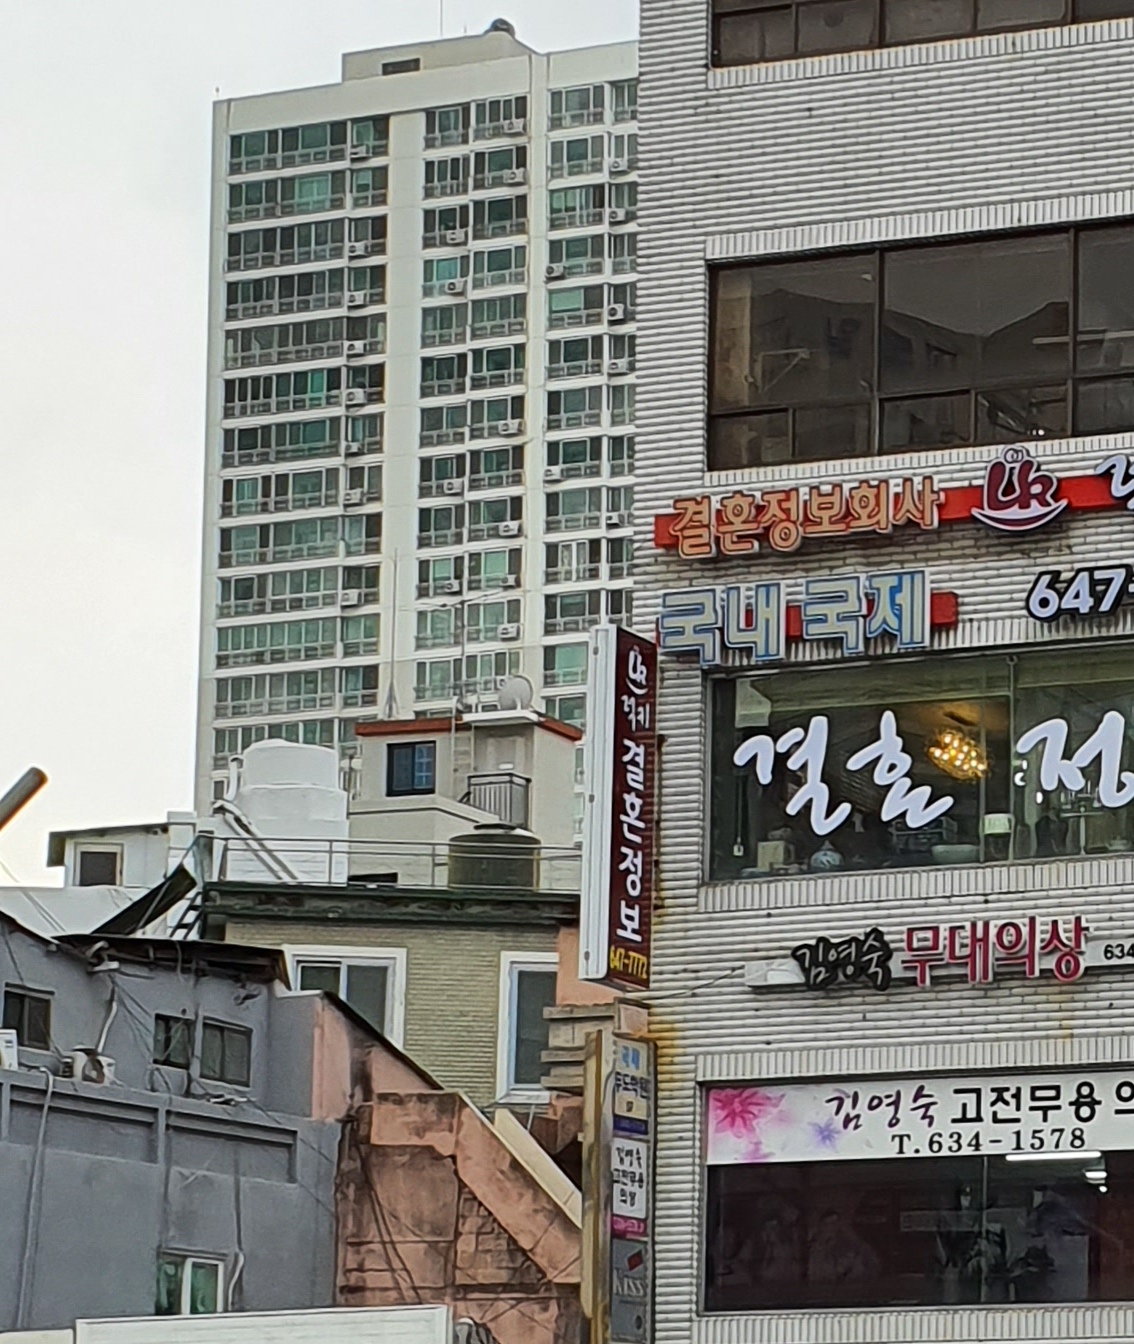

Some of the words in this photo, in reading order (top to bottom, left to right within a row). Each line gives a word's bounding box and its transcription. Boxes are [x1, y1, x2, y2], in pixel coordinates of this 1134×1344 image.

[669, 475, 941, 558] 결혼정보회사
[659, 582, 784, 665] 국내
[802, 570, 930, 655] 국제
[616, 738, 646, 943] 결혼정보
[794, 931, 888, 987] 김영숙
[901, 915, 1091, 987] 무대의상
[825, 1084, 939, 1131] 김영숙
[950, 1080, 1102, 1125] 고전무용
[890, 1127, 1087, 1156] T.634-1578
